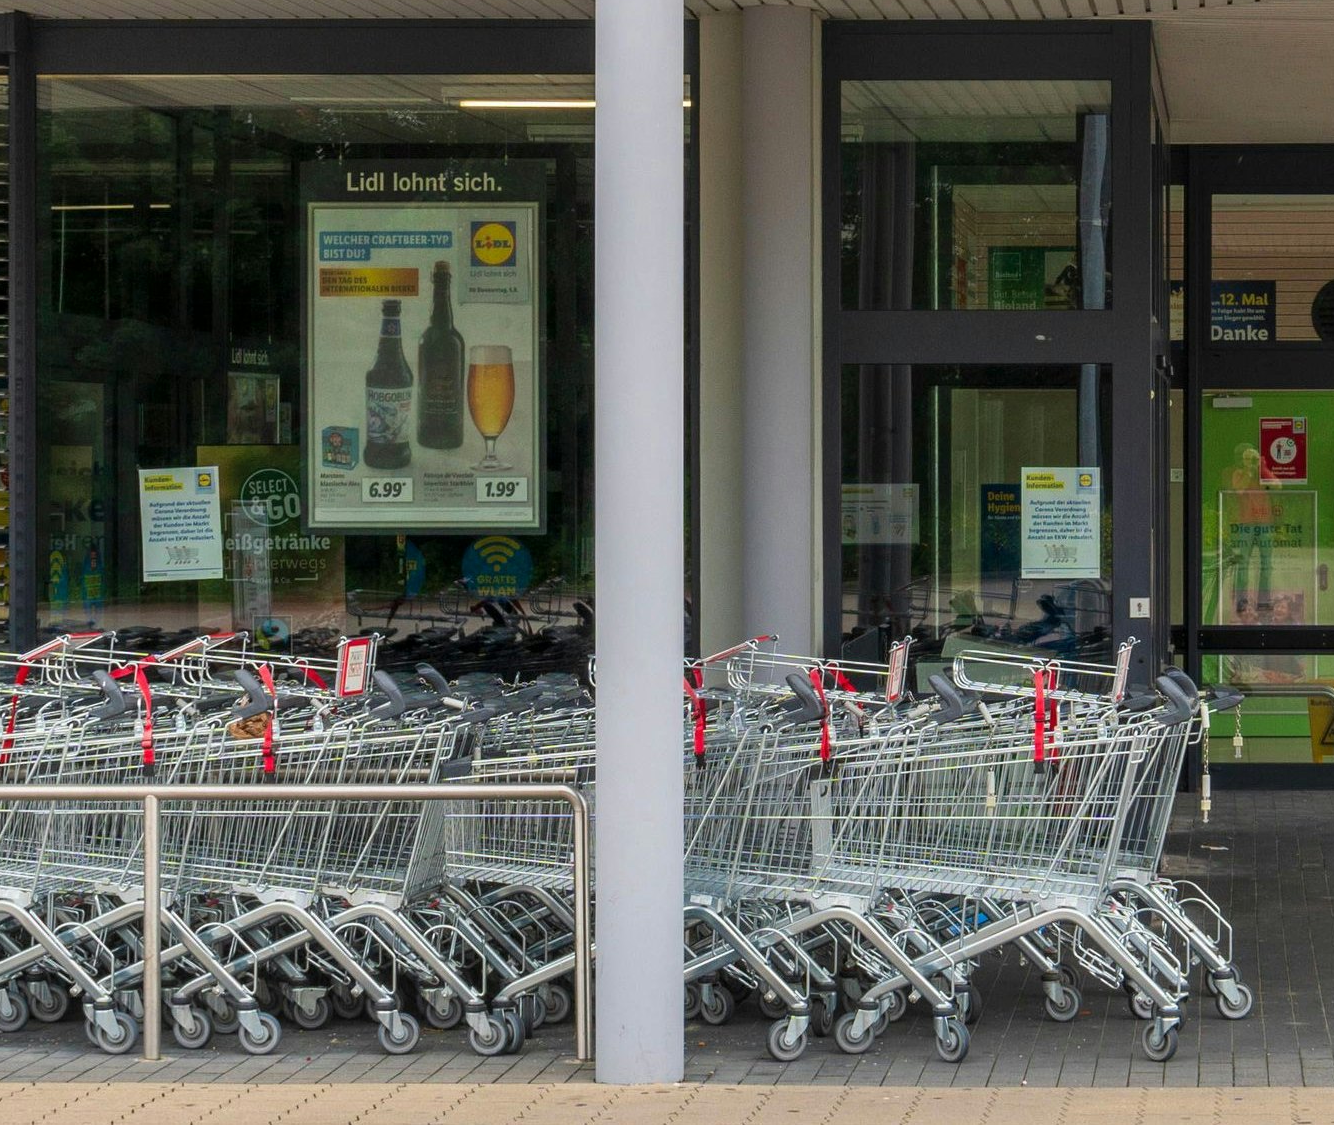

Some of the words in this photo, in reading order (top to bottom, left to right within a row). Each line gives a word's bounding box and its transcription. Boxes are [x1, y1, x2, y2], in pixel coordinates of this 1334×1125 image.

[346, 172, 384, 192] Lidl
[393, 172, 447, 192] lohnt
[453, 172, 503, 192] sich.
[323, 235, 370, 245] WELCHER
[371, 235, 449, 245] CRAFTBEER-TYP
[323, 249, 345, 259] BIST
[346, 249, 366, 259] DU?
[1220, 293, 1239, 306] 12.
[1241, 293, 1269, 306] Mal
[1211, 325, 1269, 342] Danke
[248, 479, 288, 495] SELECT
[987, 491, 1015, 502] Deine
[987, 502, 1021, 513] Hygien
[1230, 523, 1251, 534] Die
[1285, 524, 1303, 534] Tat
[225, 533, 331, 555] eißgetränke
[1251, 537, 1302, 549] Automat
[476, 574, 517, 584] GRATIS
[477, 586, 516, 597] WLAN
